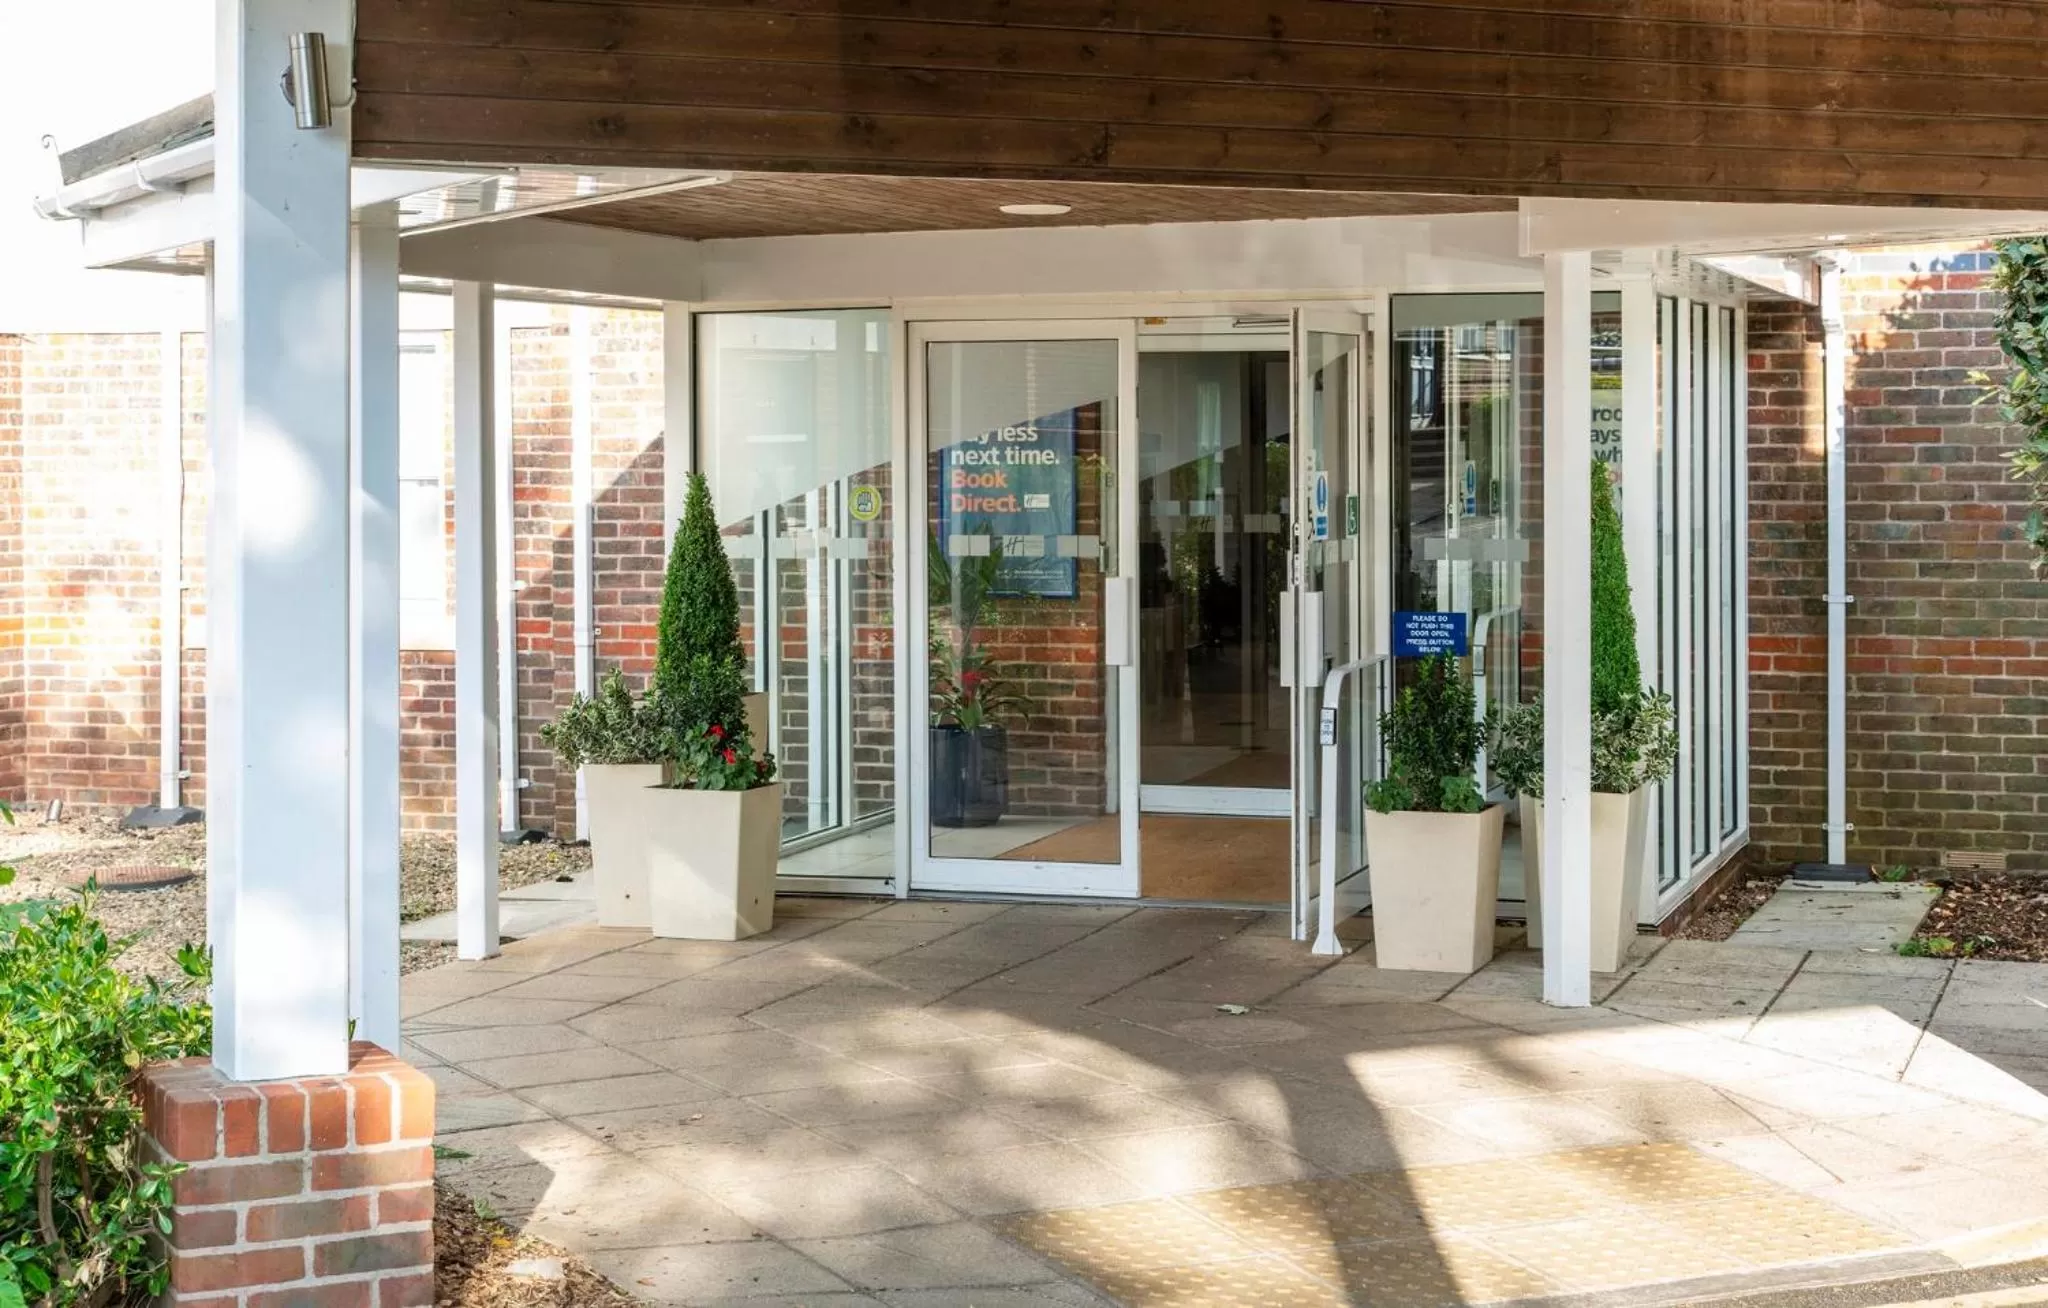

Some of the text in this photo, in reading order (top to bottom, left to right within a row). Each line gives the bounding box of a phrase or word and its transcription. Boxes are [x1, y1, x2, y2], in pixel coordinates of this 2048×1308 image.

[997, 424, 1039, 442] less
[951, 445, 1060, 465] next time.
[951, 468, 1008, 488] Book
[951, 492, 1021, 513] Direct.
